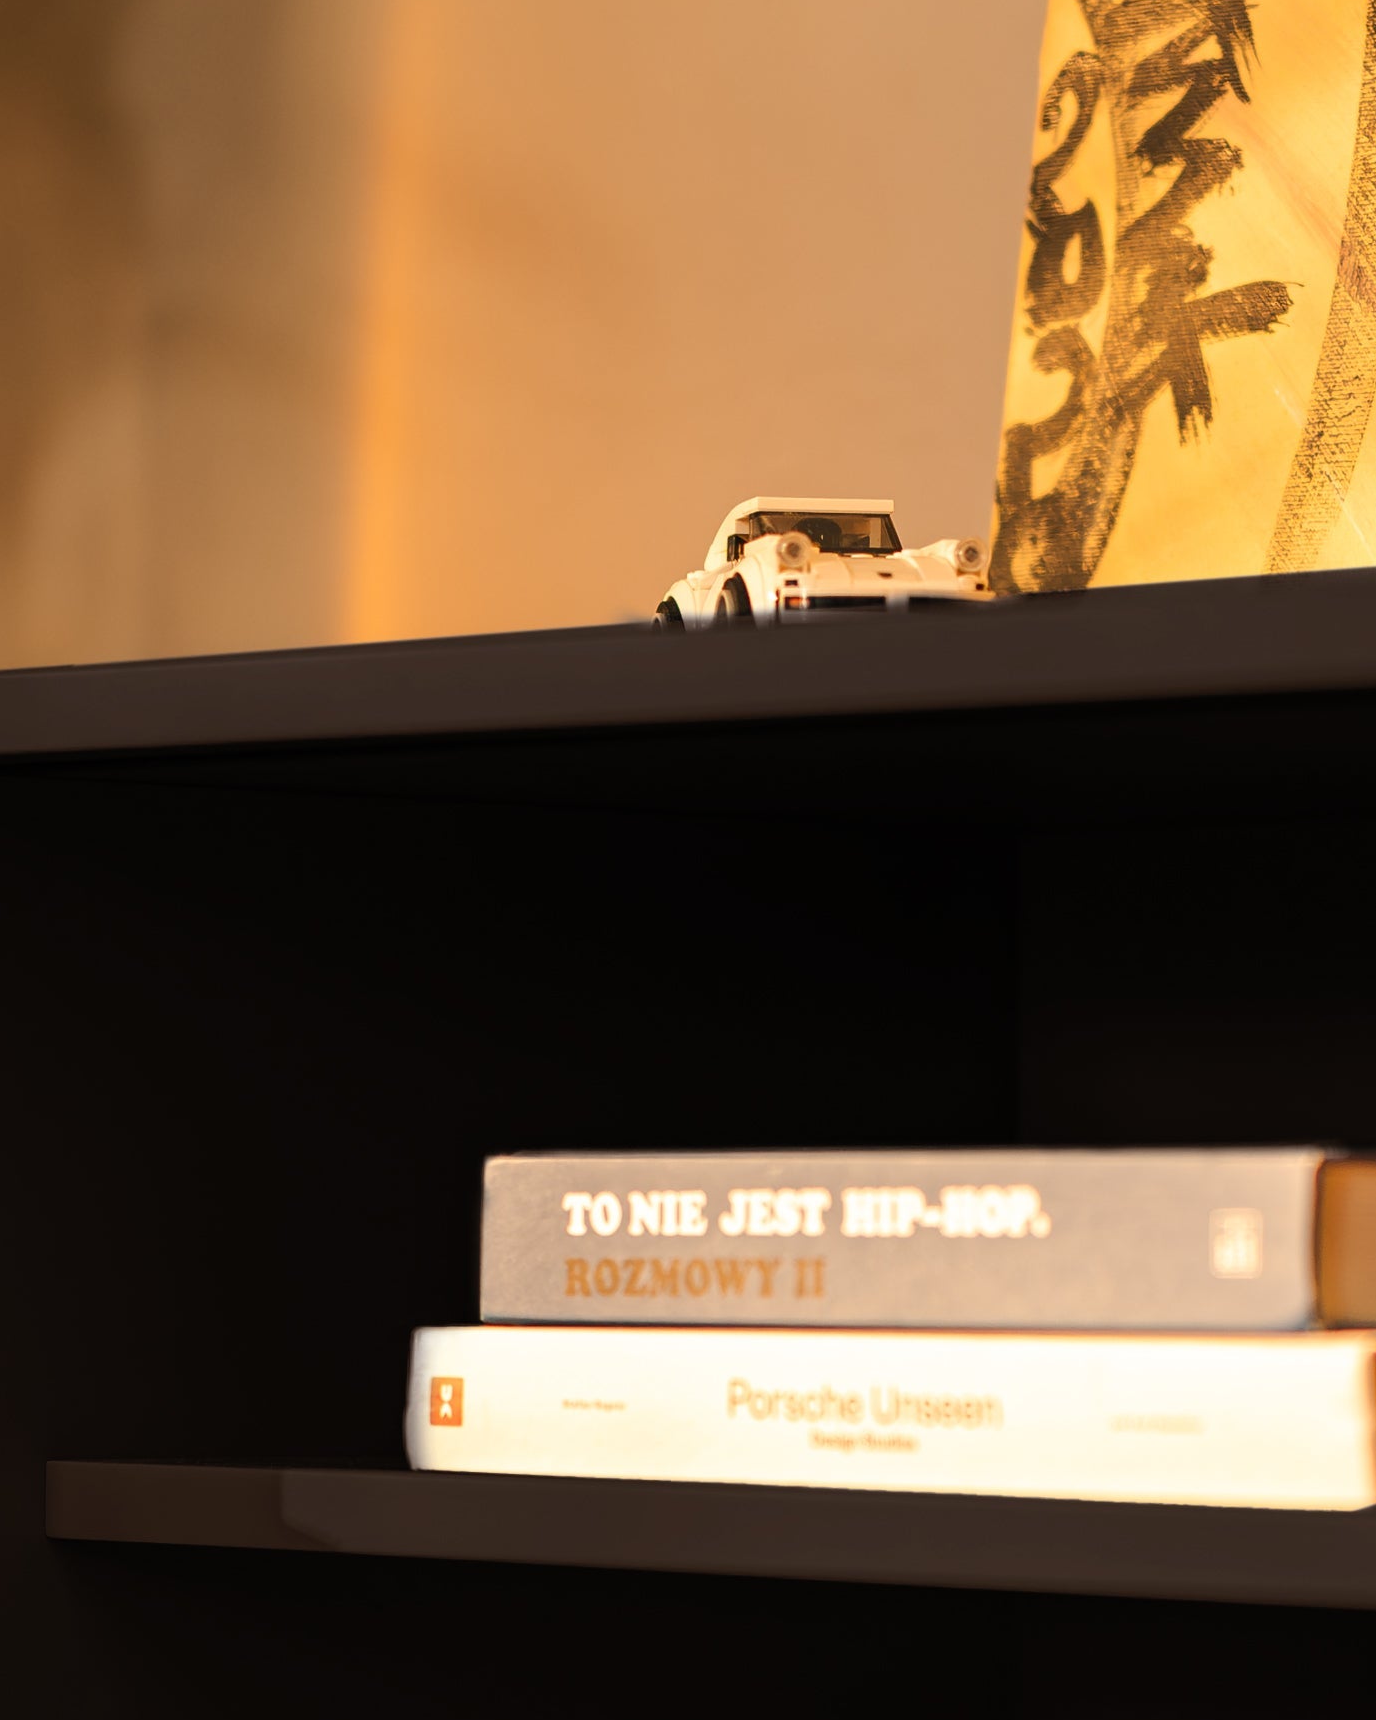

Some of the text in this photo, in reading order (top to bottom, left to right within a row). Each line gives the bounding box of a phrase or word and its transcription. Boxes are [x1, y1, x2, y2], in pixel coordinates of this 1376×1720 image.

[562, 1185, 1052, 1238] TO NIE JEST HIP-HOP.
[564, 1256, 829, 1299] ROZMOWY II
[727, 1377, 1005, 1430] Porsche Unseen
